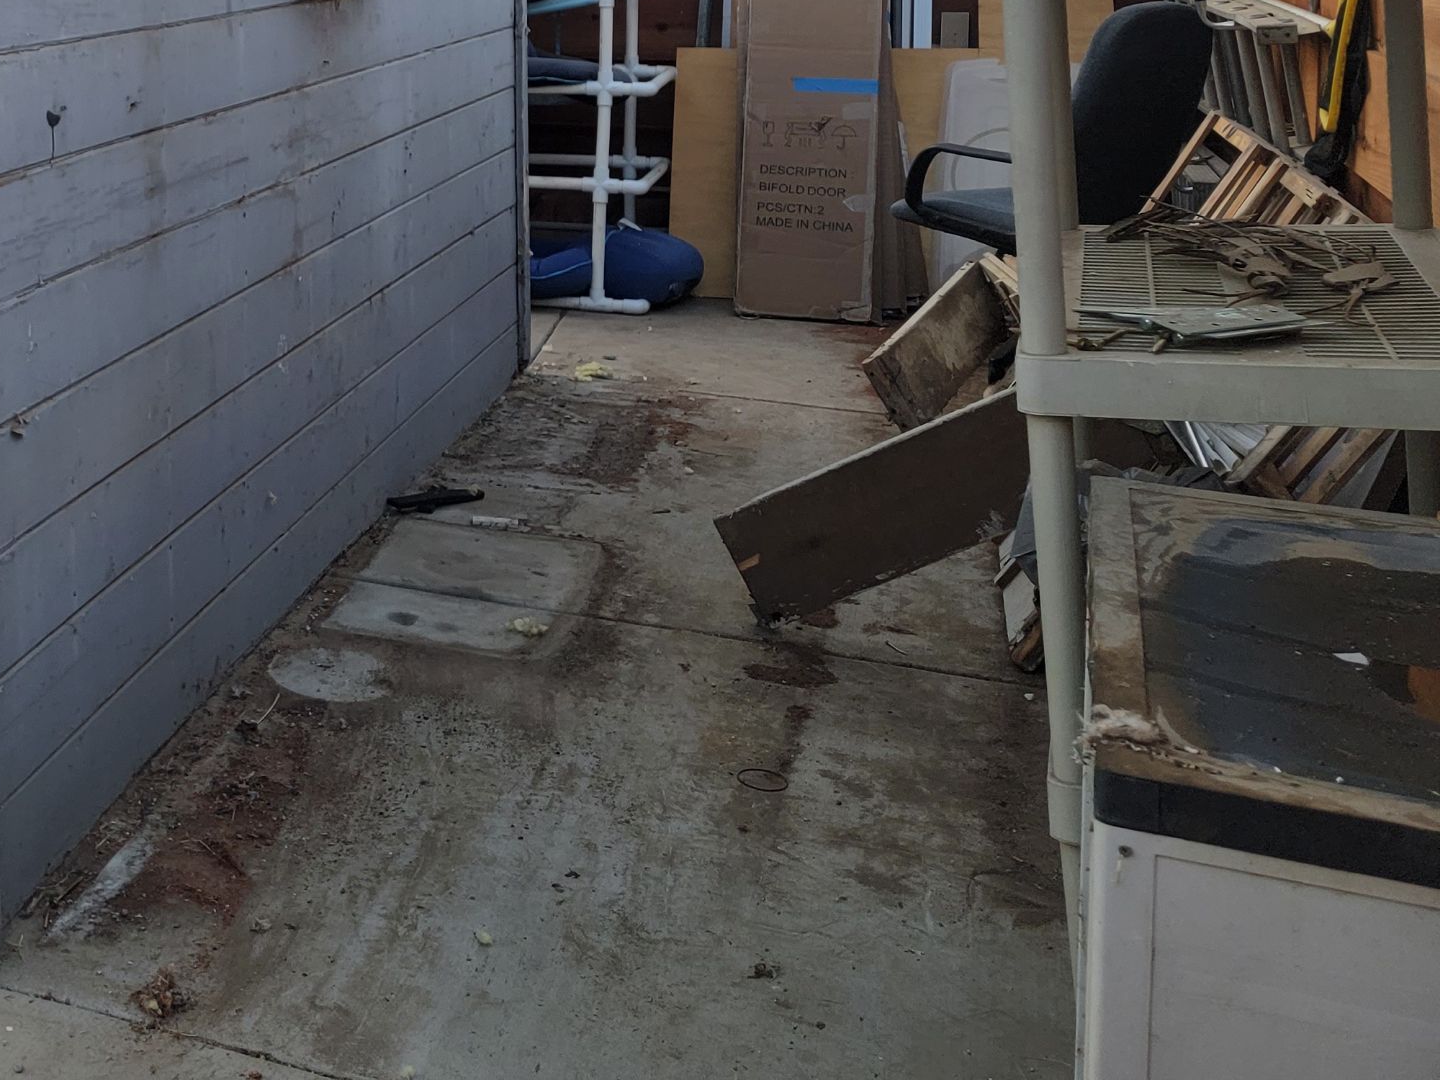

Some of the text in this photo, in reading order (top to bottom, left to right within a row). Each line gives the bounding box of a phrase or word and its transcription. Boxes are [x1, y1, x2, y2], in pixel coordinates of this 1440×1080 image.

[759, 163, 847, 178] DESCRIPTION
[758, 181, 847, 197] BIFOLD DOOR
[755, 215, 854, 233] MADE IN CHINA
